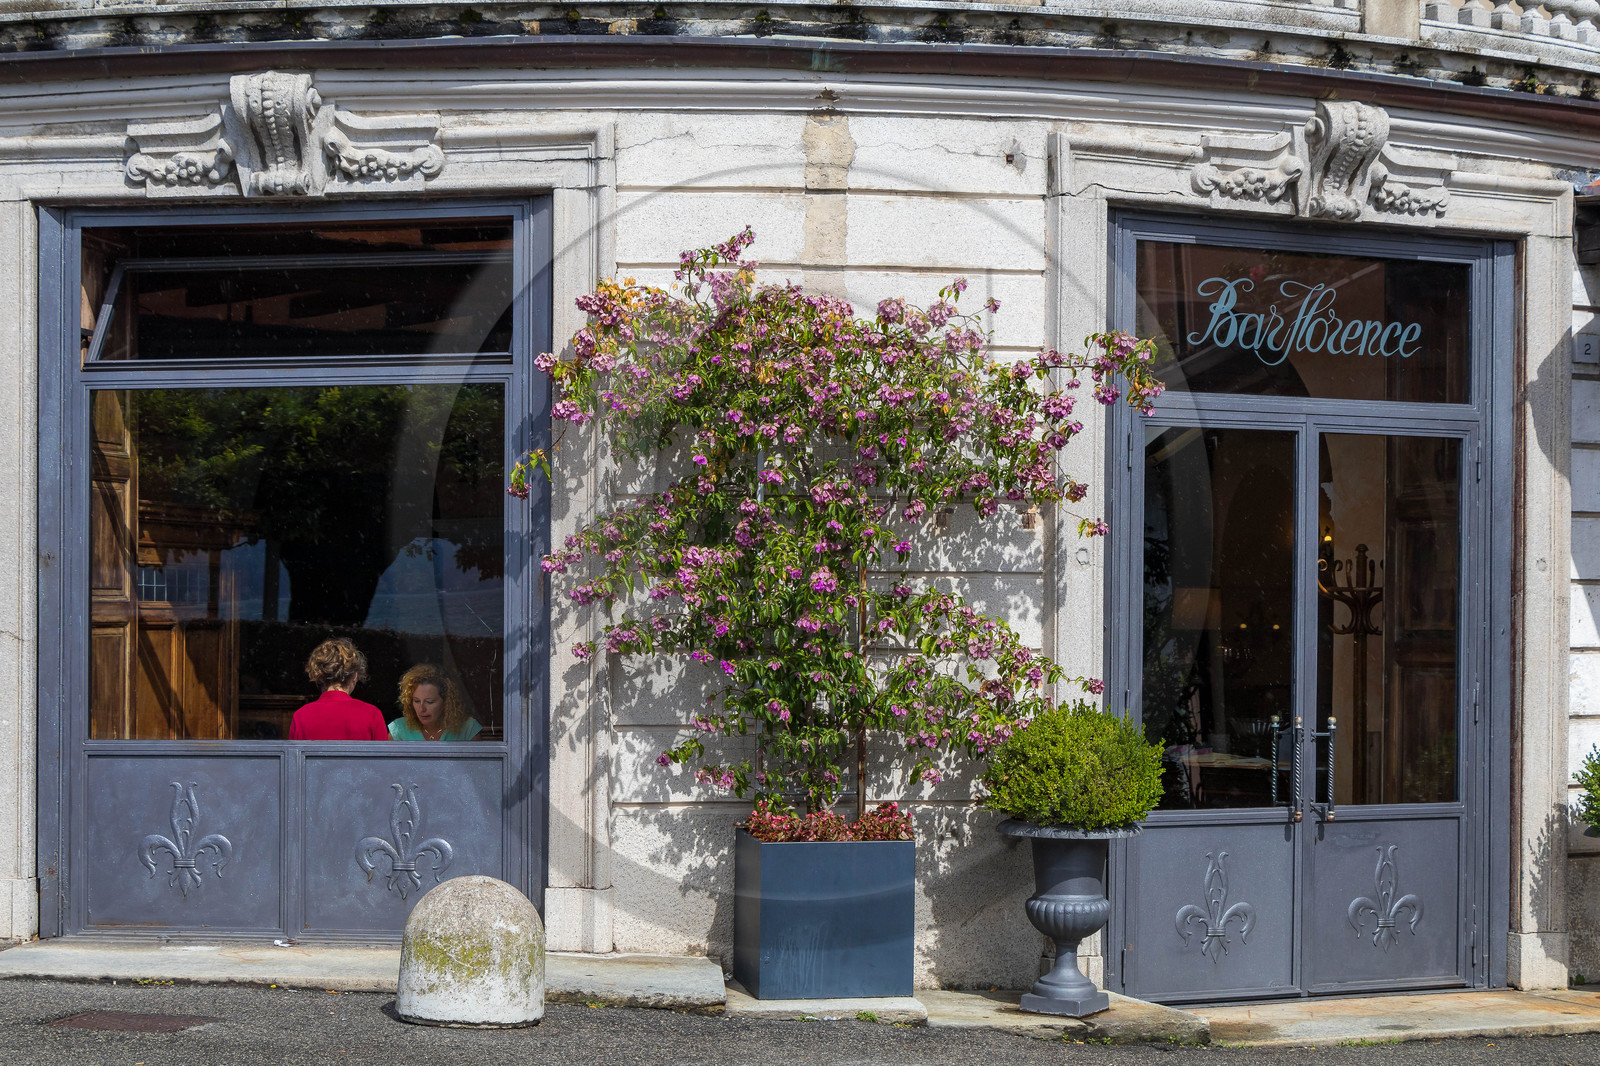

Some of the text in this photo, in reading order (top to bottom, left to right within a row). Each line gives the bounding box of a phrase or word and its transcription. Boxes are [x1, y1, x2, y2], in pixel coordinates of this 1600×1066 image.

[1187, 277, 1422, 366] Bar Florence
[1584, 343, 1592, 356] 2
